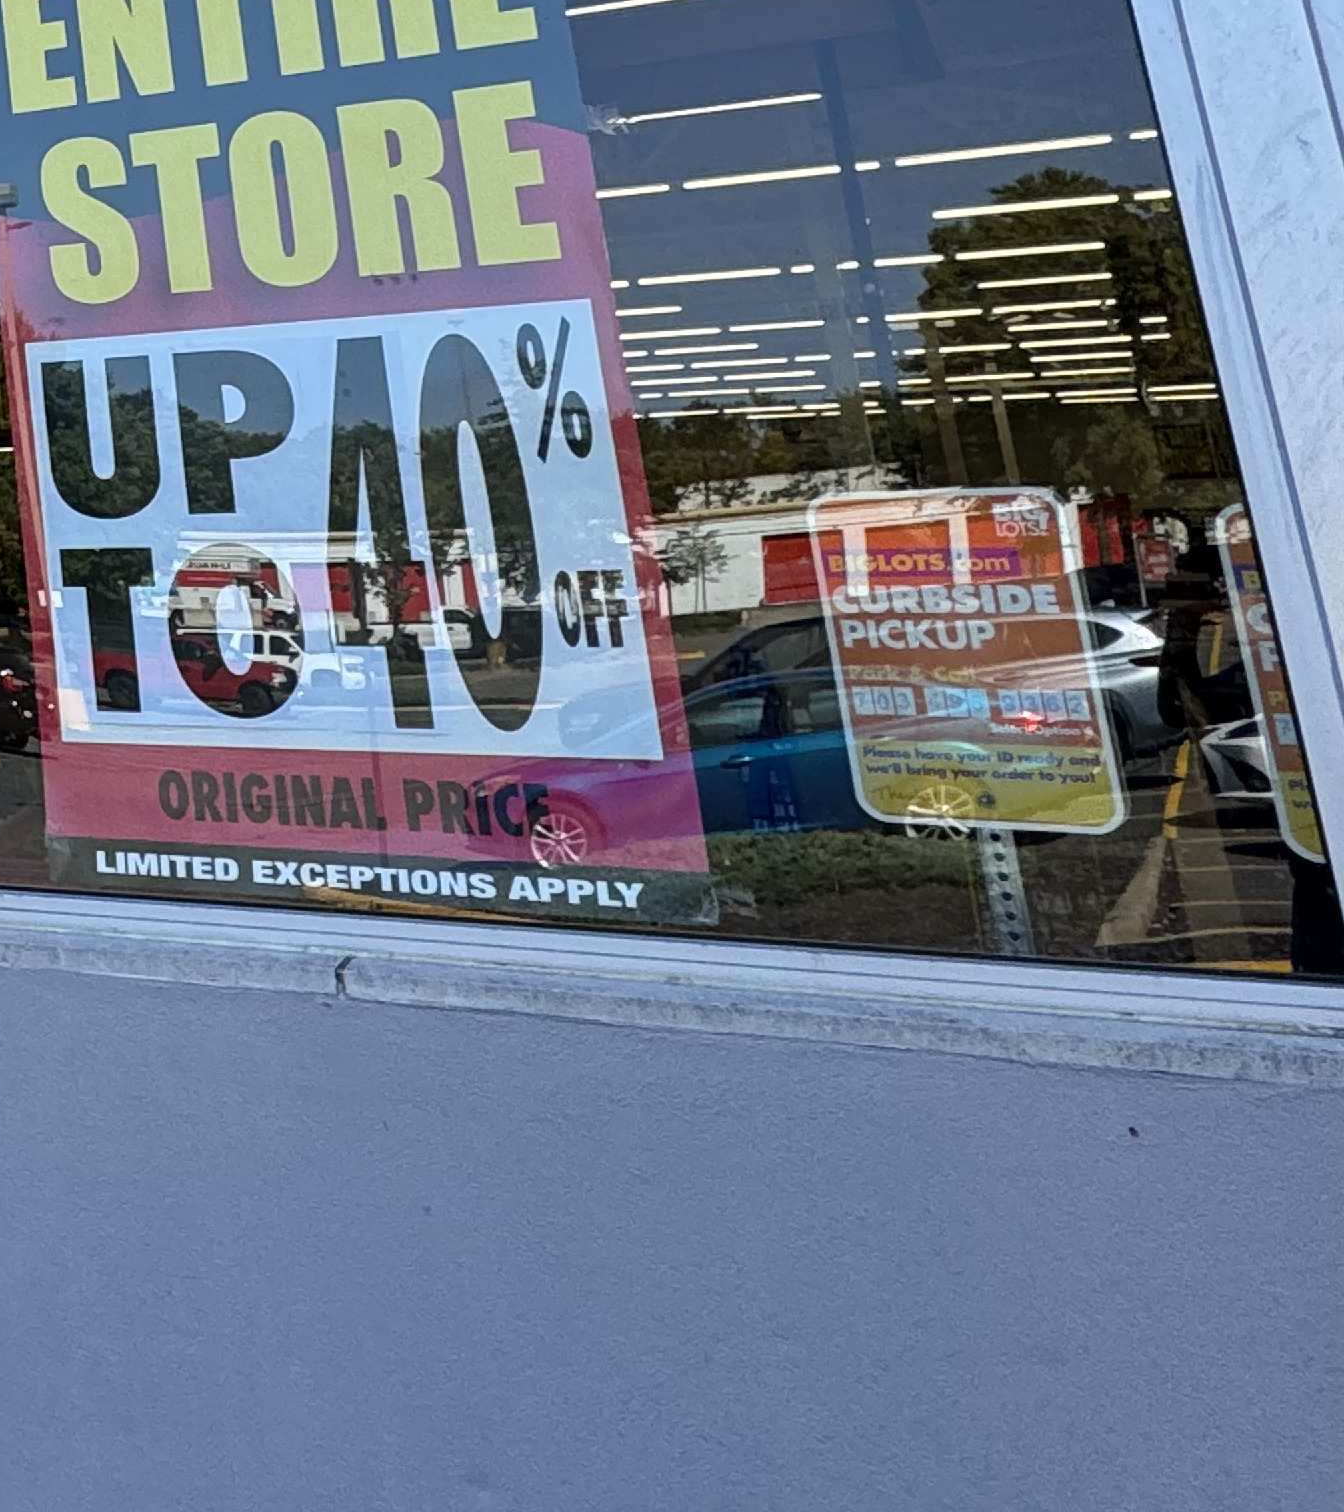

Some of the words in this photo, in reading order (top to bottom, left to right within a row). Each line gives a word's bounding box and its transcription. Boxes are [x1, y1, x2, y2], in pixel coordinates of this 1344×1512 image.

[40, 79, 562, 305] STORE
[38, 350, 296, 521] UP
[59, 540, 300, 721] TO
[555, 569, 630, 648] OFF
[832, 584, 1060, 614] CURBSIDE
[841, 619, 996, 650] PICKUP
[862, 745, 910, 760] Please
[915, 747, 953, 761] have
[957, 750, 991, 766] your
[996, 751, 1014, 763] ID
[1017, 753, 1064, 768] ready
[1068, 754, 1101, 768] and
[866, 763, 902, 776] we'll
[906, 764, 948, 780] bring
[953, 767, 987, 782] your
[991, 768, 1034, 781] order
[1038, 770, 1055, 782] to
[1059, 770, 1097, 785] you!
[157, 767, 384, 833] ORIGINAL
[402, 779, 553, 838] PRICE
[95, 850, 239, 884] LIMITED
[250, 858, 497, 901] EXCEPTIONS
[508, 872, 644, 911] APPLY
